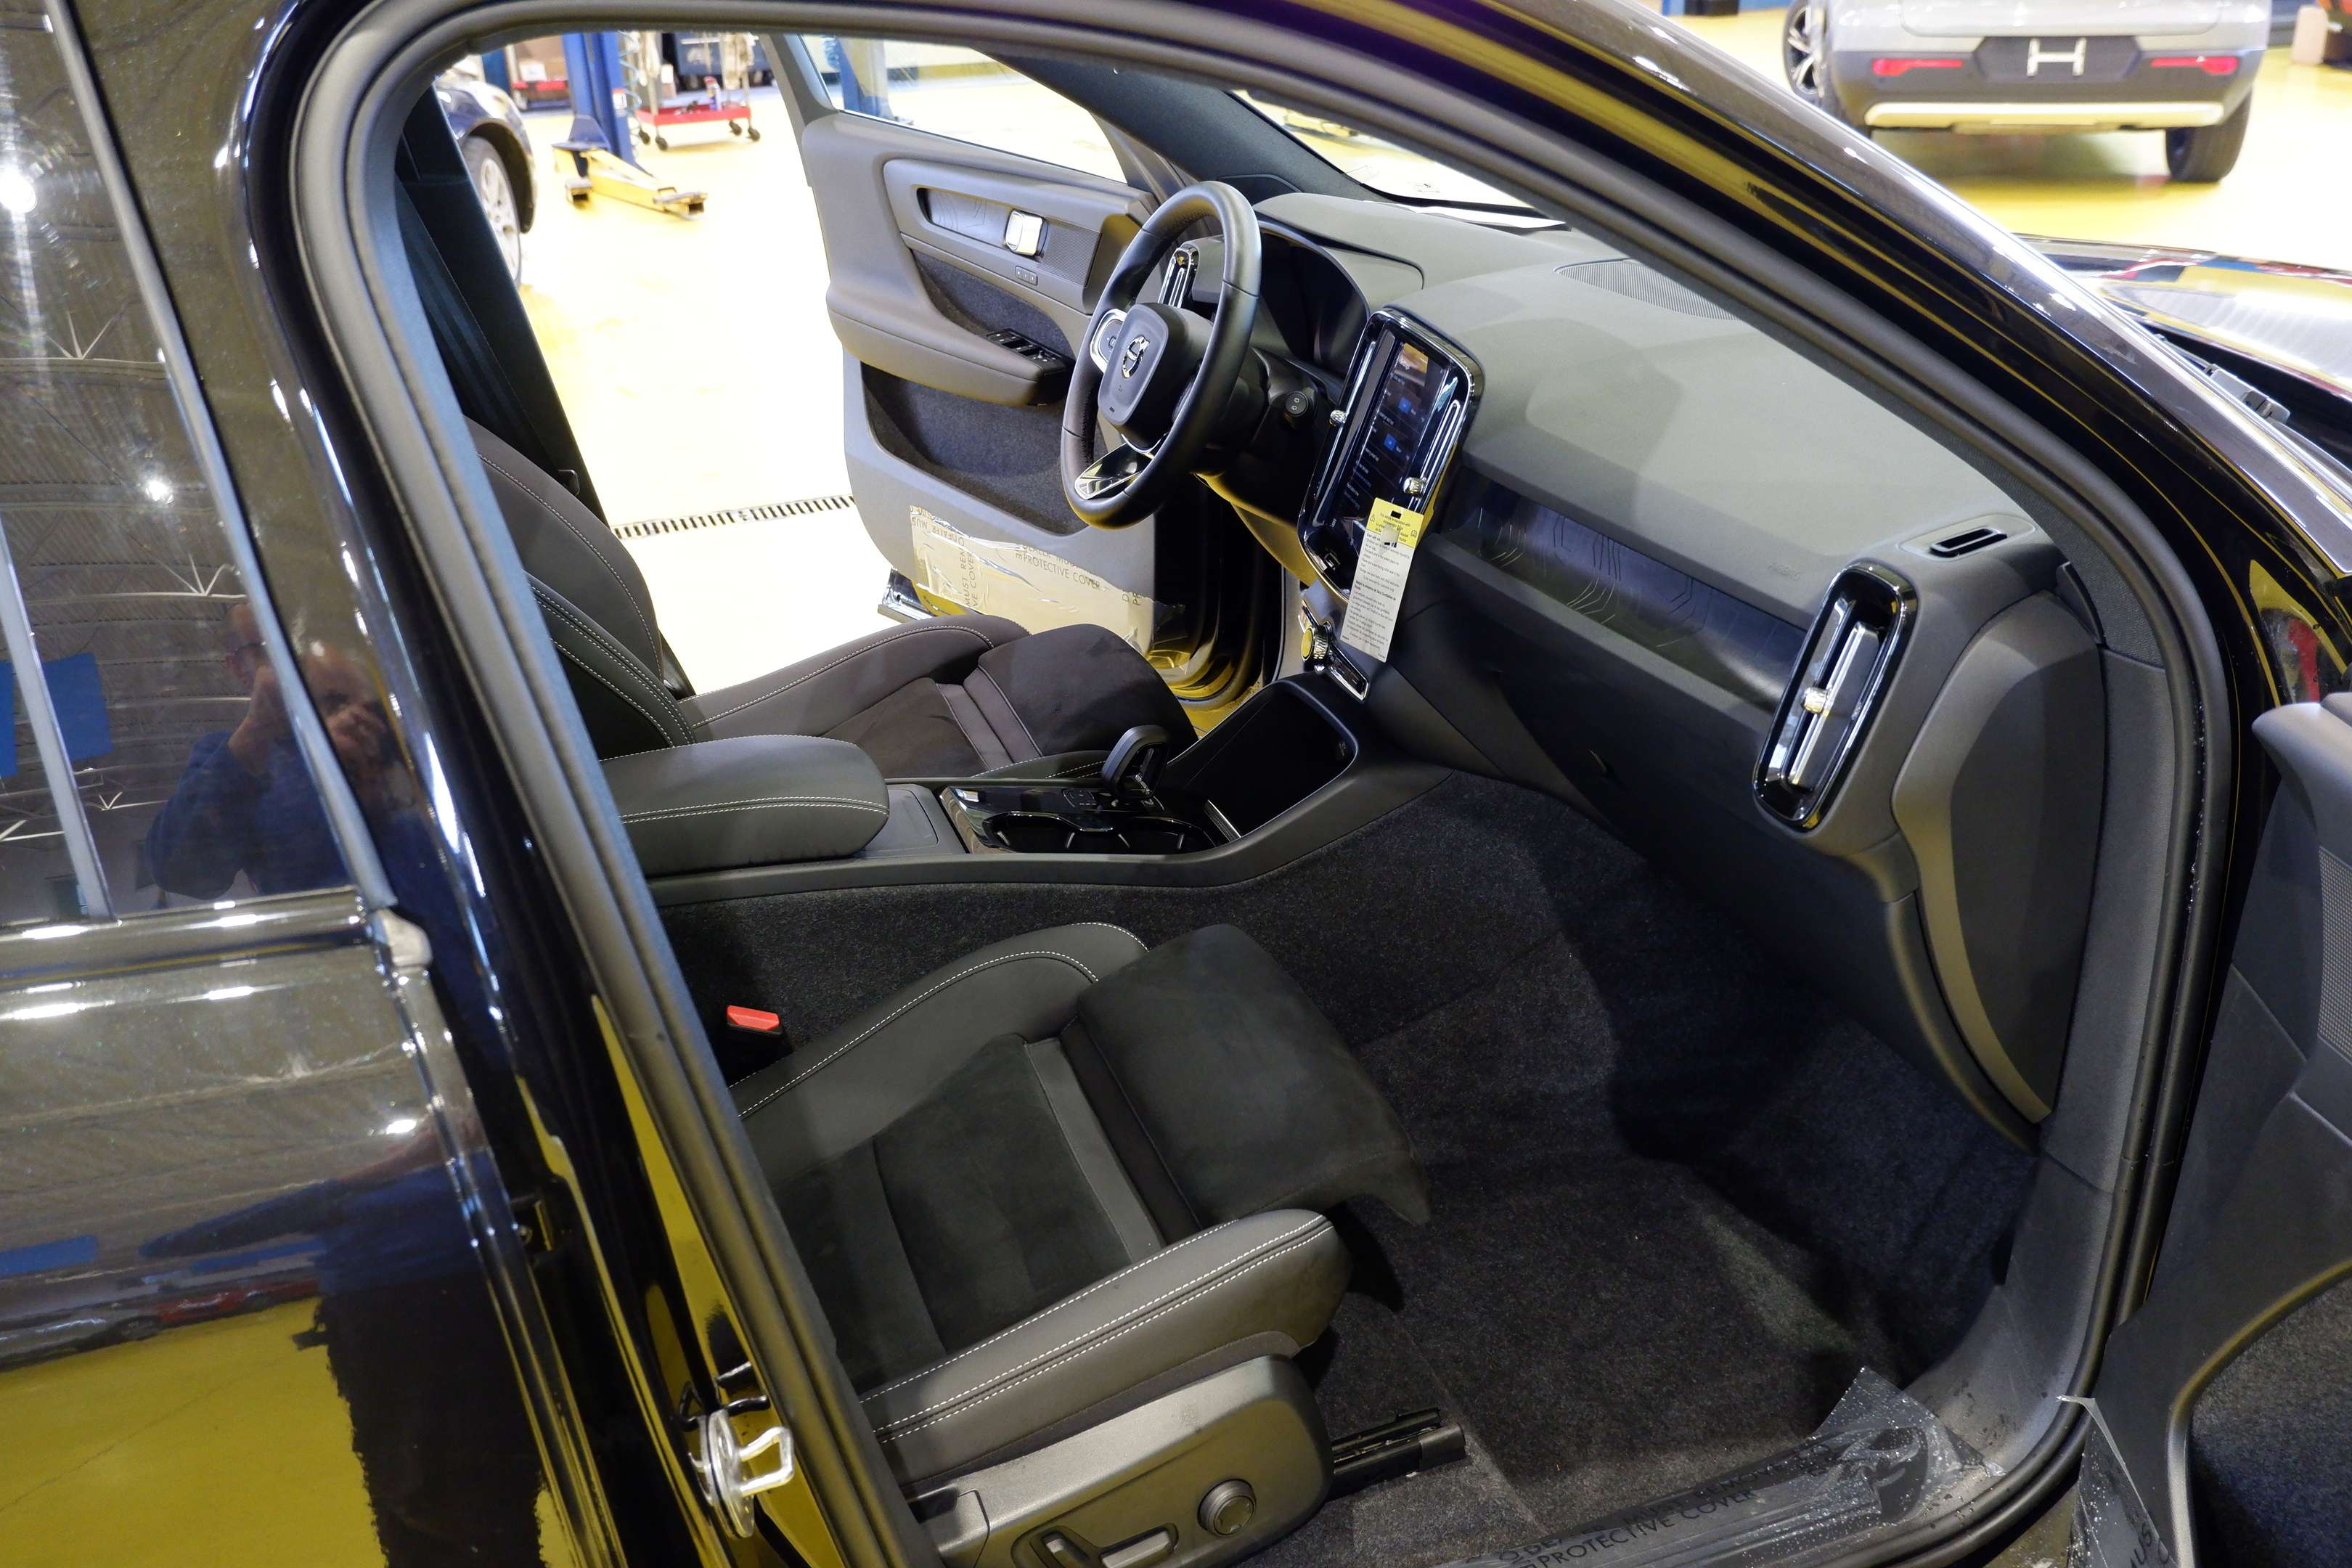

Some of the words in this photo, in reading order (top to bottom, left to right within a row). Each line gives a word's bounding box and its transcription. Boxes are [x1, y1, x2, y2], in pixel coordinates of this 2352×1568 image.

[1024, 553, 1069, 579] PROTECTIVE
[1537, 1517, 1675, 1568] PROTECTIVE
[1681, 1490, 1757, 1519] COVER
